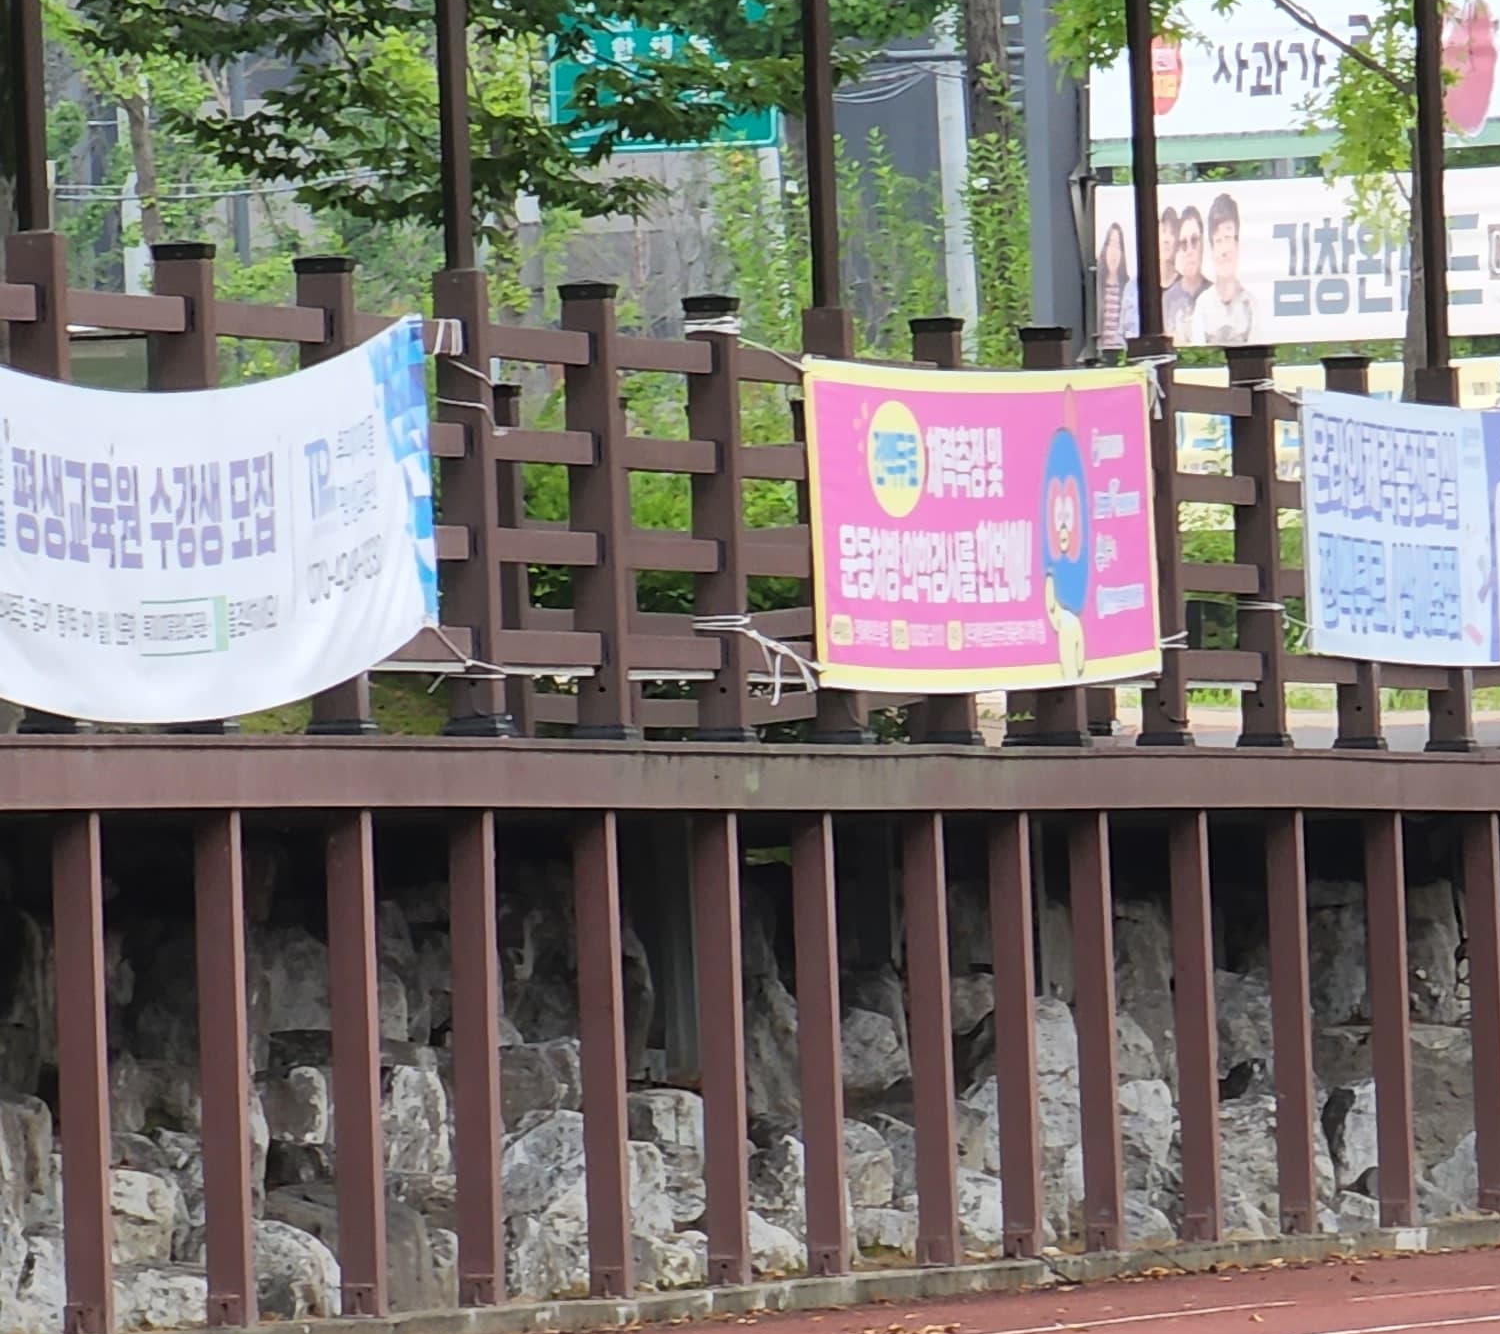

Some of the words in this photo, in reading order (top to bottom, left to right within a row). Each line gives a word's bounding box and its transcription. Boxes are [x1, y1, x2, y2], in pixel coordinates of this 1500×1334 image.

[1212, 38, 1327, 97] 사과가
[1272, 213, 1483, 317] 김창완드
[11, 447, 144, 570] 평생교육원
[149, 461, 224, 571] 수강생
[229, 450, 277, 560] 모집
